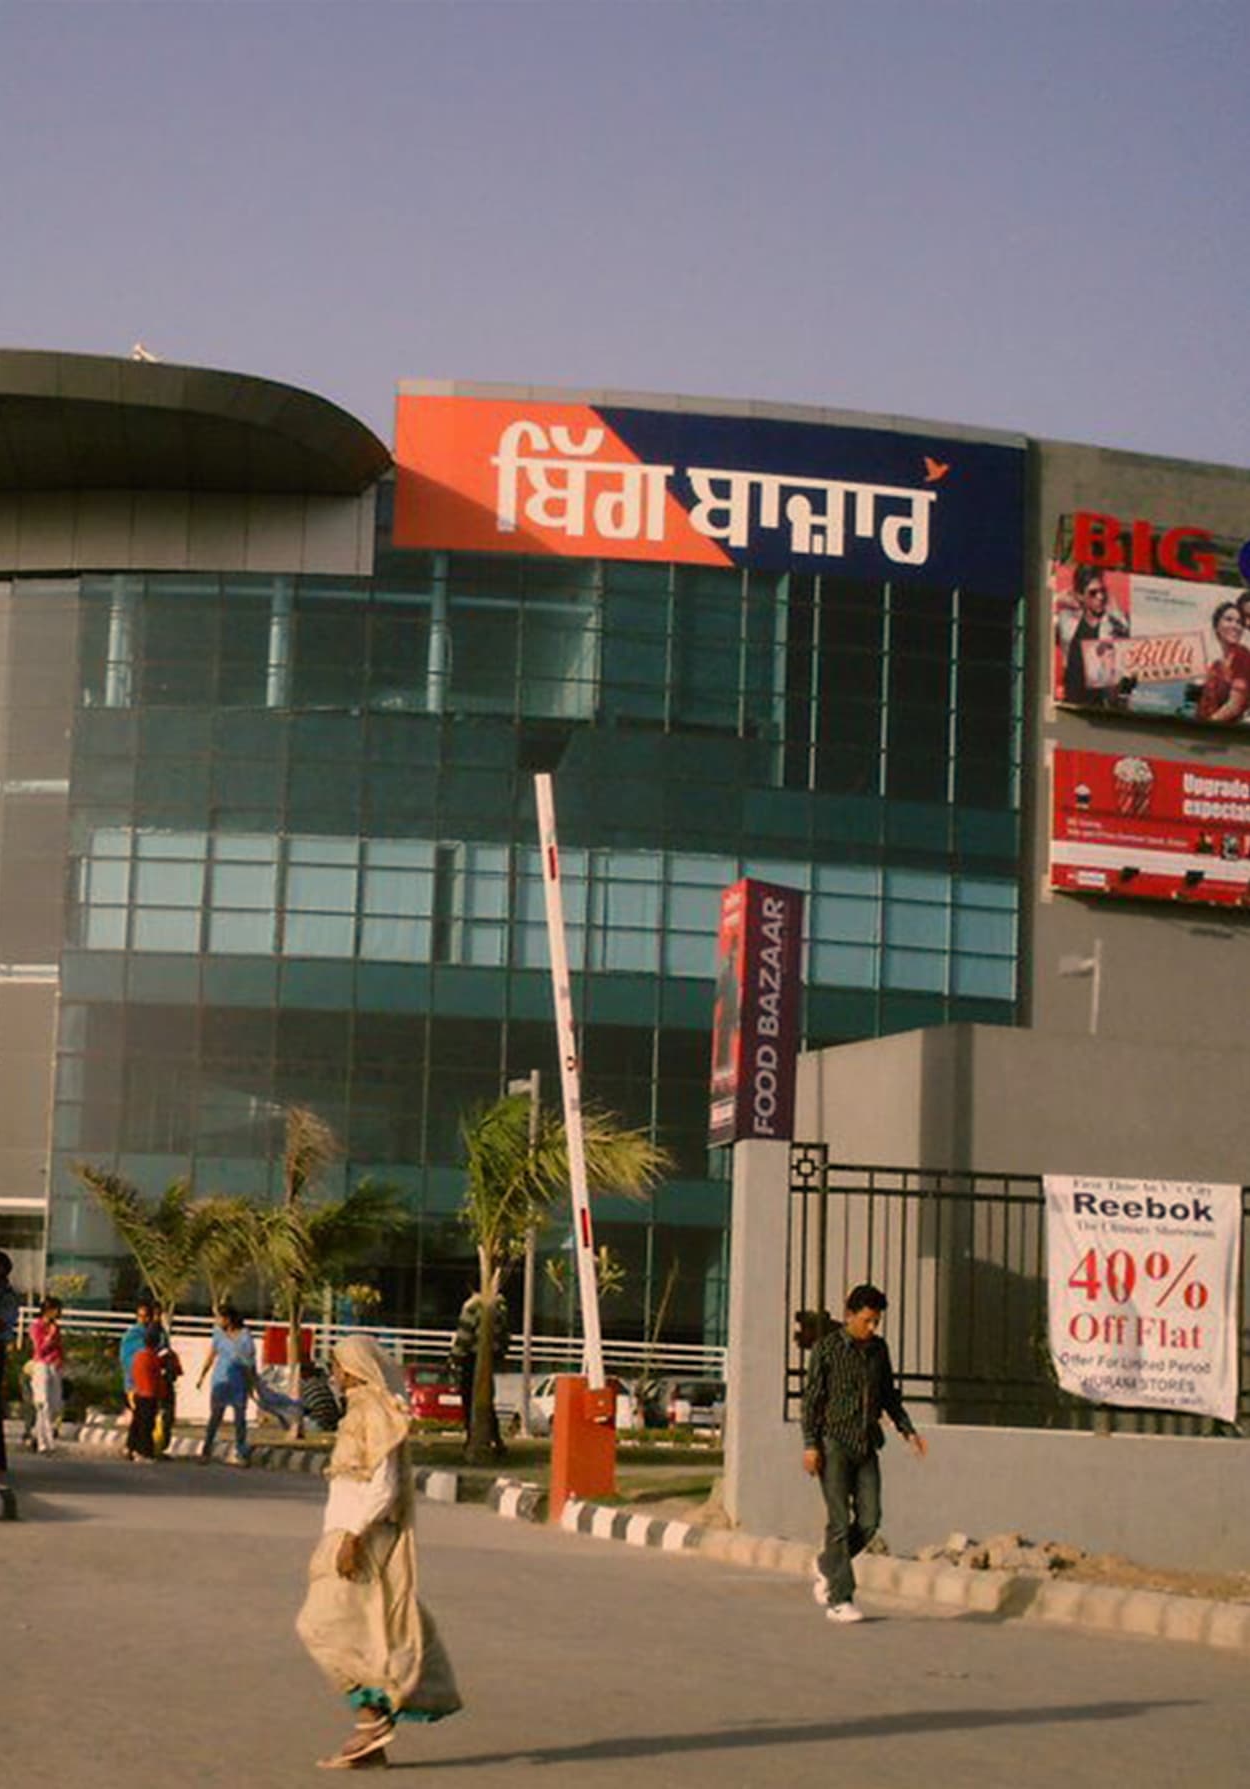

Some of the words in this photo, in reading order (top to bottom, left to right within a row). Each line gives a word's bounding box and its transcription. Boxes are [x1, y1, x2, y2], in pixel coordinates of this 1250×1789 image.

[490, 421, 674, 541] ਬਿੱਗ
[1072, 510, 1218, 582] BIG
[757, 896, 784, 1036] BAZAAR
[753, 1050, 778, 1135] FOOD
[1073, 1192, 1213, 1222] Reebok
[1068, 1248, 1208, 1311] 40%
[1068, 1312, 1128, 1345] Off
[1136, 1315, 1203, 1349] Flat
